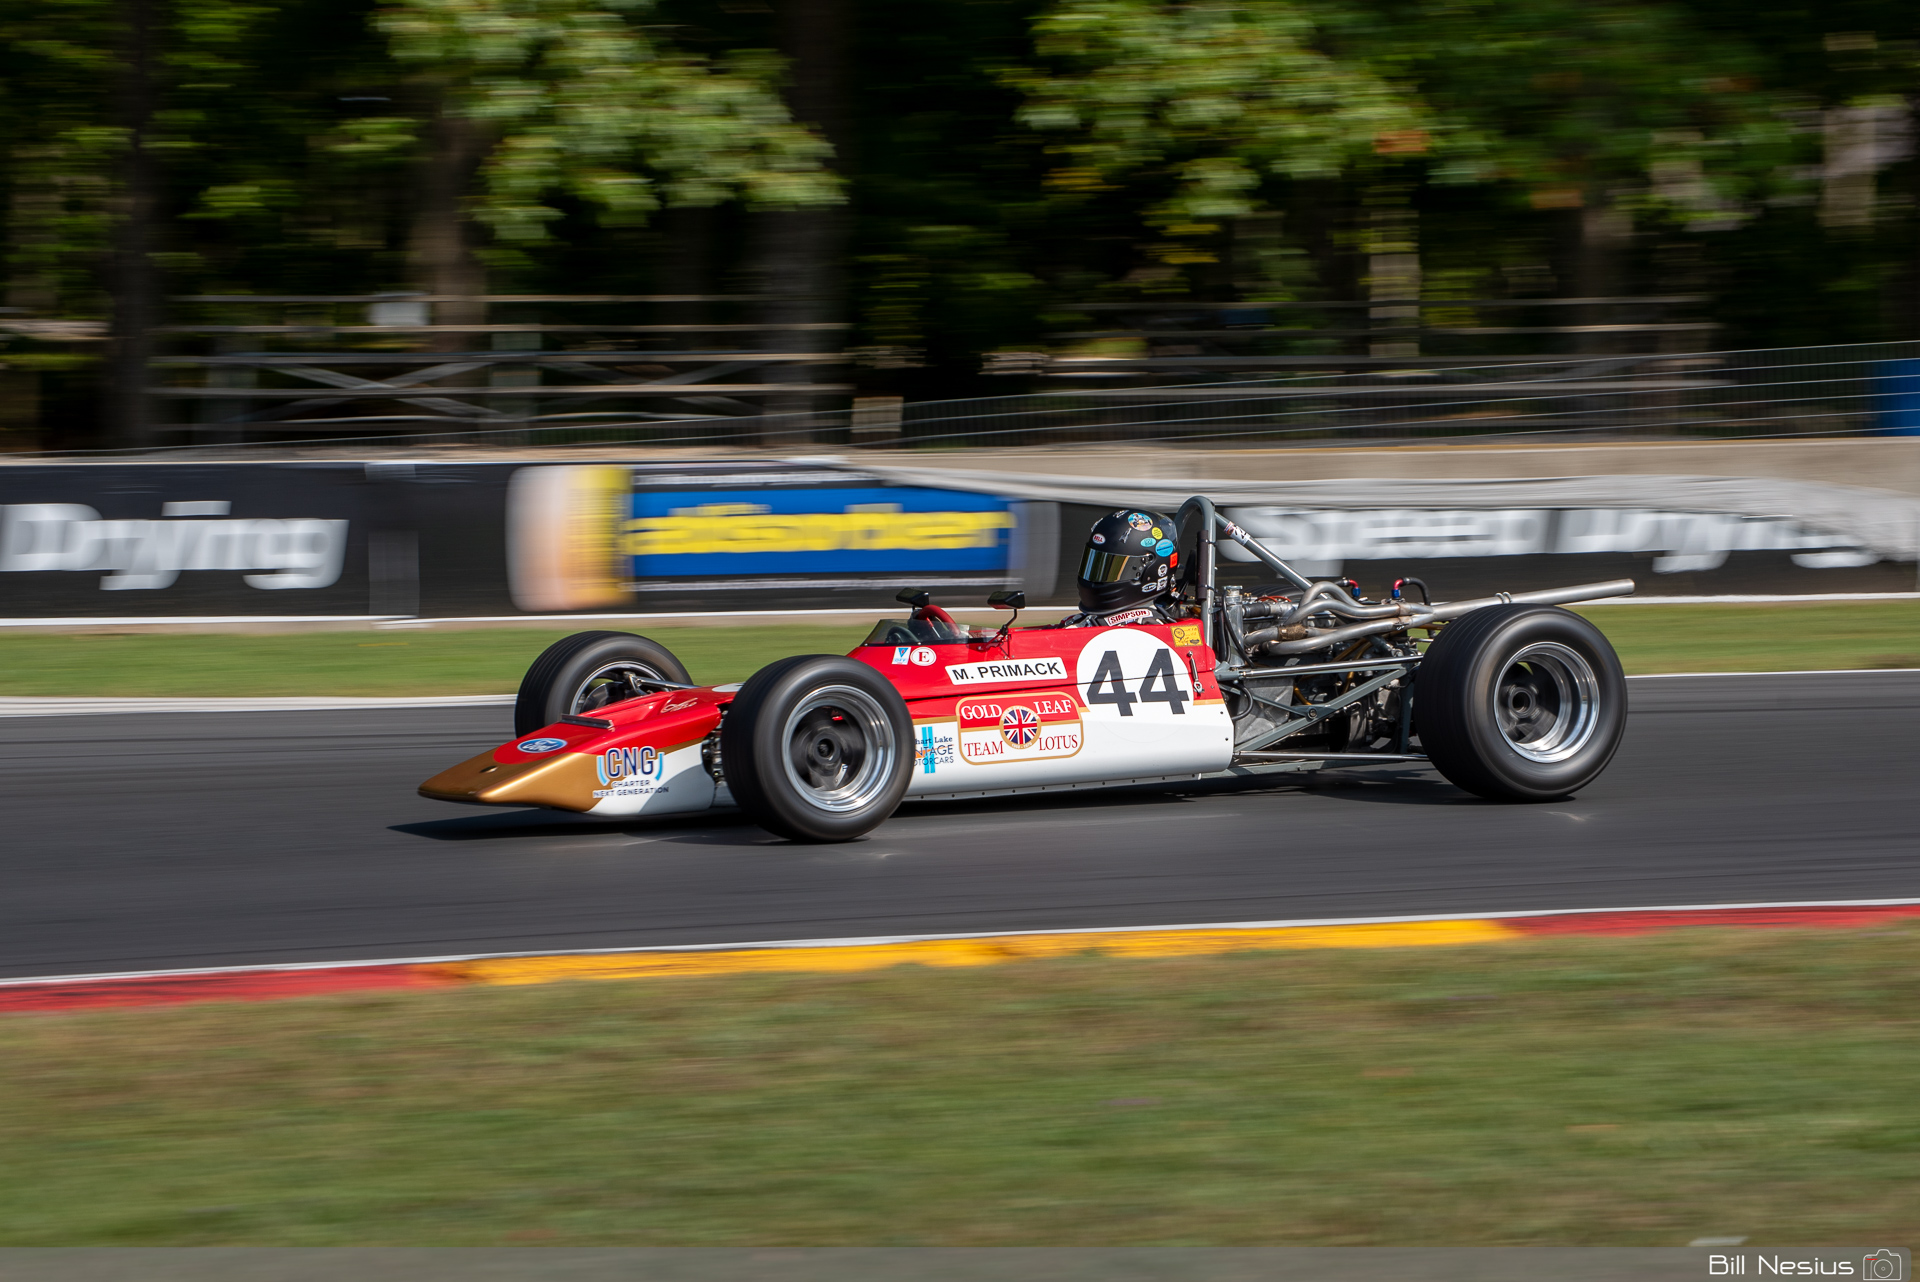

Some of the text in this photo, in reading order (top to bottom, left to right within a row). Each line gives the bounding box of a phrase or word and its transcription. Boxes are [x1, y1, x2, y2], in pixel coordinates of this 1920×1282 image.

[0, 500, 349, 590] Drying
[1111, 610, 1147, 624] SIMPSON
[918, 651, 930, 663] E
[952, 661, 1062, 681] M. PRIMACK
[1086, 648, 1190, 717] 44
[960, 704, 1003, 720] GOLD
[1033, 699, 1072, 715] LEAF
[915, 735, 953, 745] hart Lake
[964, 740, 1005, 757] TEAM
[1038, 734, 1079, 751] LOTUS
[914, 744, 954, 757] NTAGE
[606, 746, 655, 778] CNG
[914, 755, 954, 766] OTORCARS
[612, 779, 650, 788] CHARTER
[593, 786, 670, 798] NEXT GENERATION
